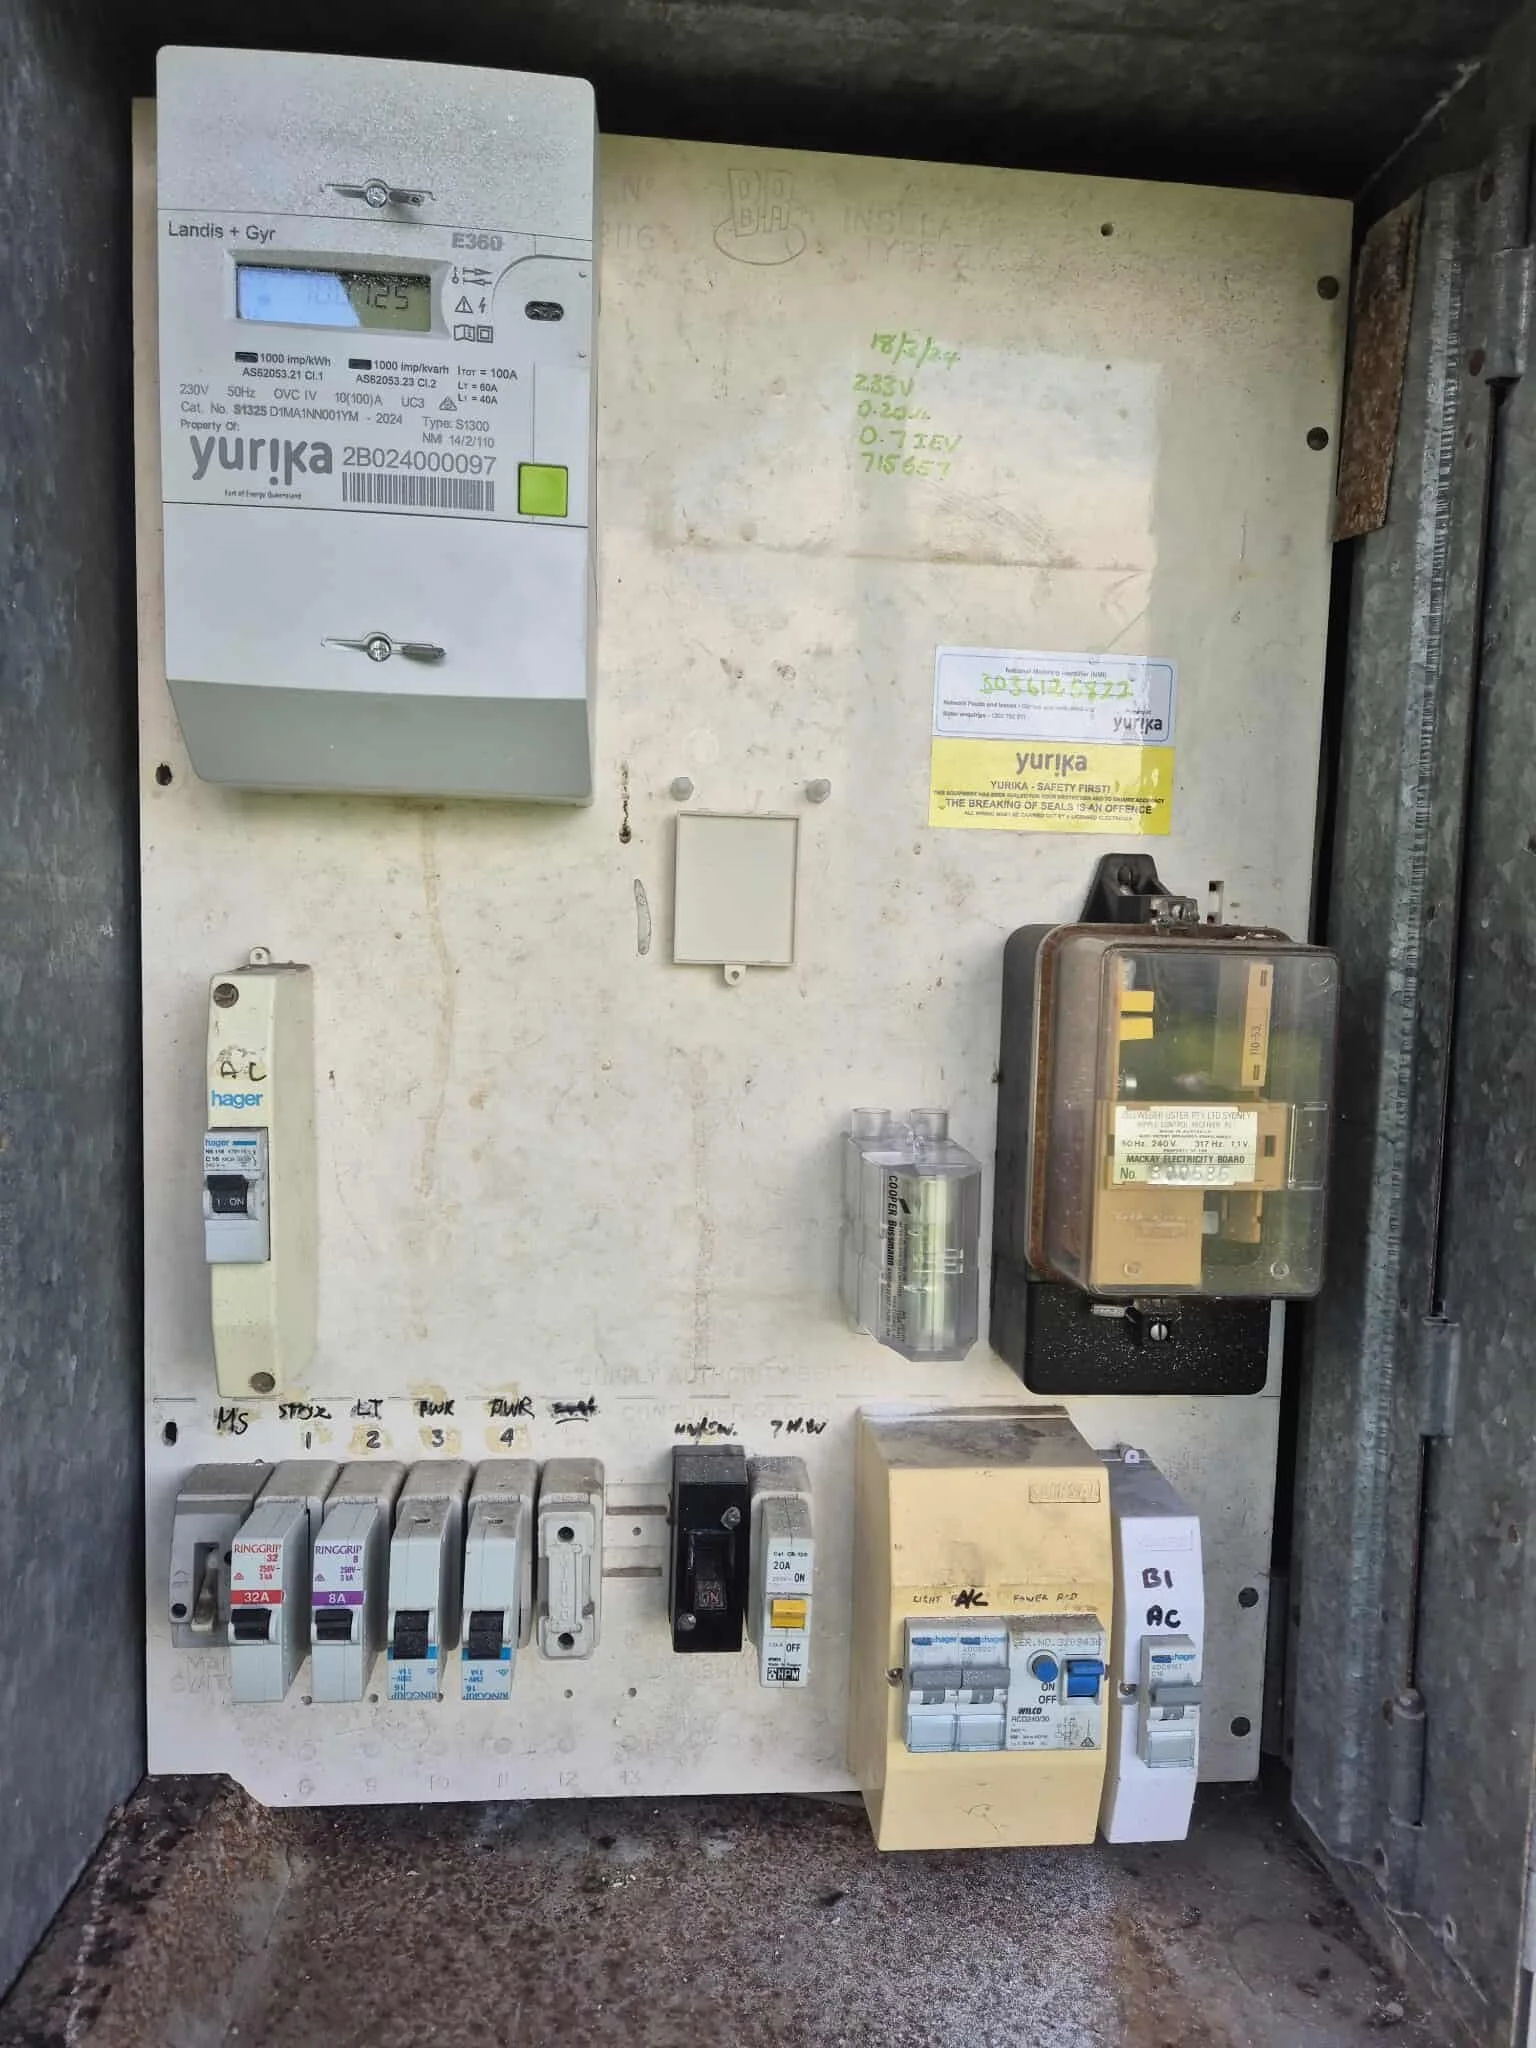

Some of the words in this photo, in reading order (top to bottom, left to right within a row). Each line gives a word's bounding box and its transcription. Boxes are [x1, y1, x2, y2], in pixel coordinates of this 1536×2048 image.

[168, 221, 224, 239] Landis
[230, 227, 240, 237] +
[246, 225, 276, 244] Gyr
[452, 232, 503, 250] E360
[260, 352, 284, 364] 1000
[287, 354, 332, 367] imp/kWh
[373, 359, 398, 371] 1000
[401, 361, 449, 375] imp/kvarh
[491, 368, 518, 380] 100A
[180, 383, 209, 396] 230V
[227, 386, 256, 399] 50Hz
[273, 388, 300, 401] OVC
[401, 396, 425, 409] UC3
[376, 411, 403, 425] 2024
[180, 419, 222, 433] Property
[455, 419, 490, 432] S1300
[449, 435, 495, 449] 14/2/110
[342, 446, 497, 475] 2B024000097
[990, 780, 1028, 791] YURIKA
[1037, 782, 1077, 792] SAFETY
[945, 798, 966, 808] THE
[968, 799, 1021, 810] BREAKING
[1024, 800, 1038, 810] OF
[1040, 801, 1073, 811] SEALS
[1105, 804, 1153, 815] OFFENCE
[210, 1089, 264, 1109] hager
[205, 1139, 230, 1148] hager
[1151, 1140, 1168, 1148] 240
[1126, 1155, 1159, 1164] MACKAY
[1162, 1155, 1214, 1164] ELECTRICITY
[1217, 1155, 1245, 1164] BOARD
[887, 1175, 899, 1217] COOPER
[886, 1219, 898, 1267] Bussmann
[216, 1406, 249, 1435] MS
[304, 1431, 312, 1450] 1
[366, 1430, 381, 1449] 2
[431, 1428, 445, 1448] 3
[500, 1427, 514, 1448] 4
[234, 1543, 282, 1554] RINGGRIP
[315, 1545, 362, 1555] RINGGRIP
[266, 1554, 278, 1563] 32
[773, 1560, 791, 1570] 20A
[794, 1572, 805, 1583] ON
[243, 1591, 270, 1603] 32A
[328, 1593, 346, 1604] 8A
[1146, 1604, 1182, 1629] AC
[786, 1643, 801, 1653] OFF
[1174, 1653, 1197, 1663] hager
[777, 1668, 800, 1681] HPM
[1041, 1682, 1056, 1692] ON
[1038, 1695, 1057, 1705] OFF
[1018, 1707, 1043, 1715] WILCO
